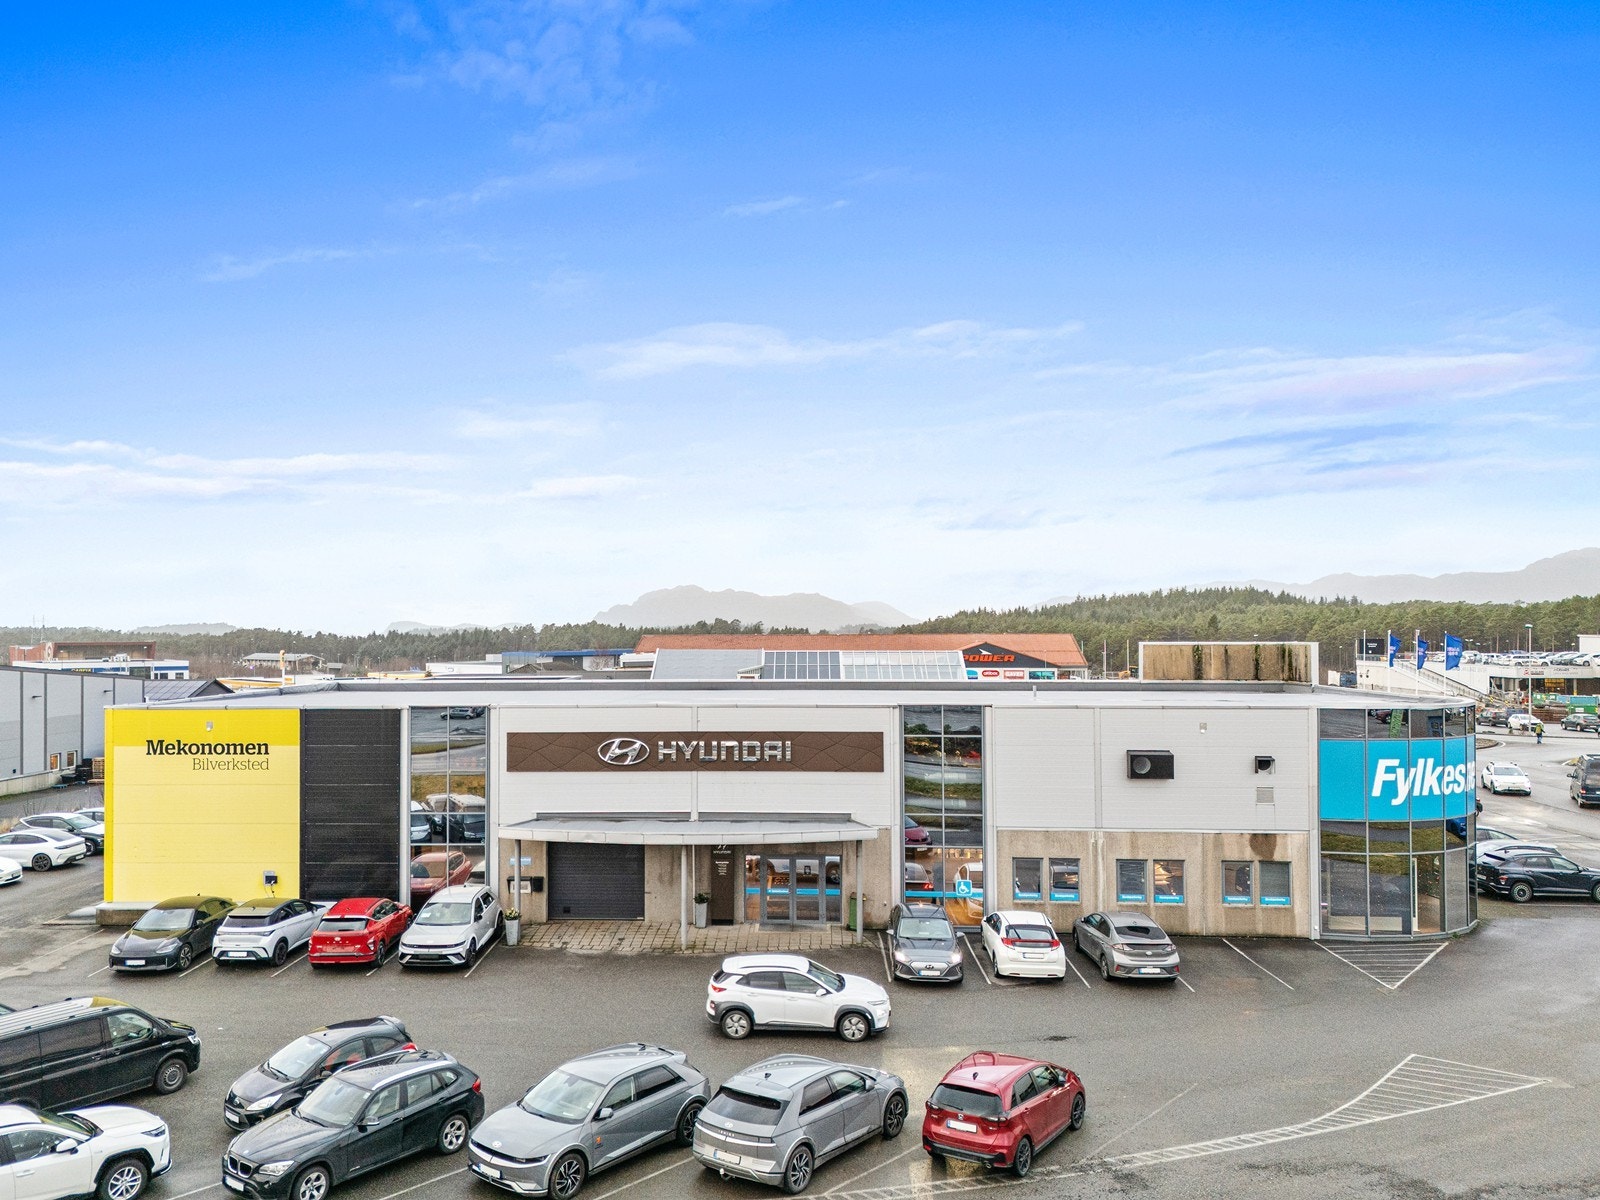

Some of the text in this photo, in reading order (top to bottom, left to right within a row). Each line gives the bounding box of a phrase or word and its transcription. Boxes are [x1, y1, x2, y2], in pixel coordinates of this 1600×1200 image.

[146, 739, 270, 755] Mekonomen
[657, 740, 792, 762] HYUNDAI
[192, 758, 270, 770] Bilverksted
